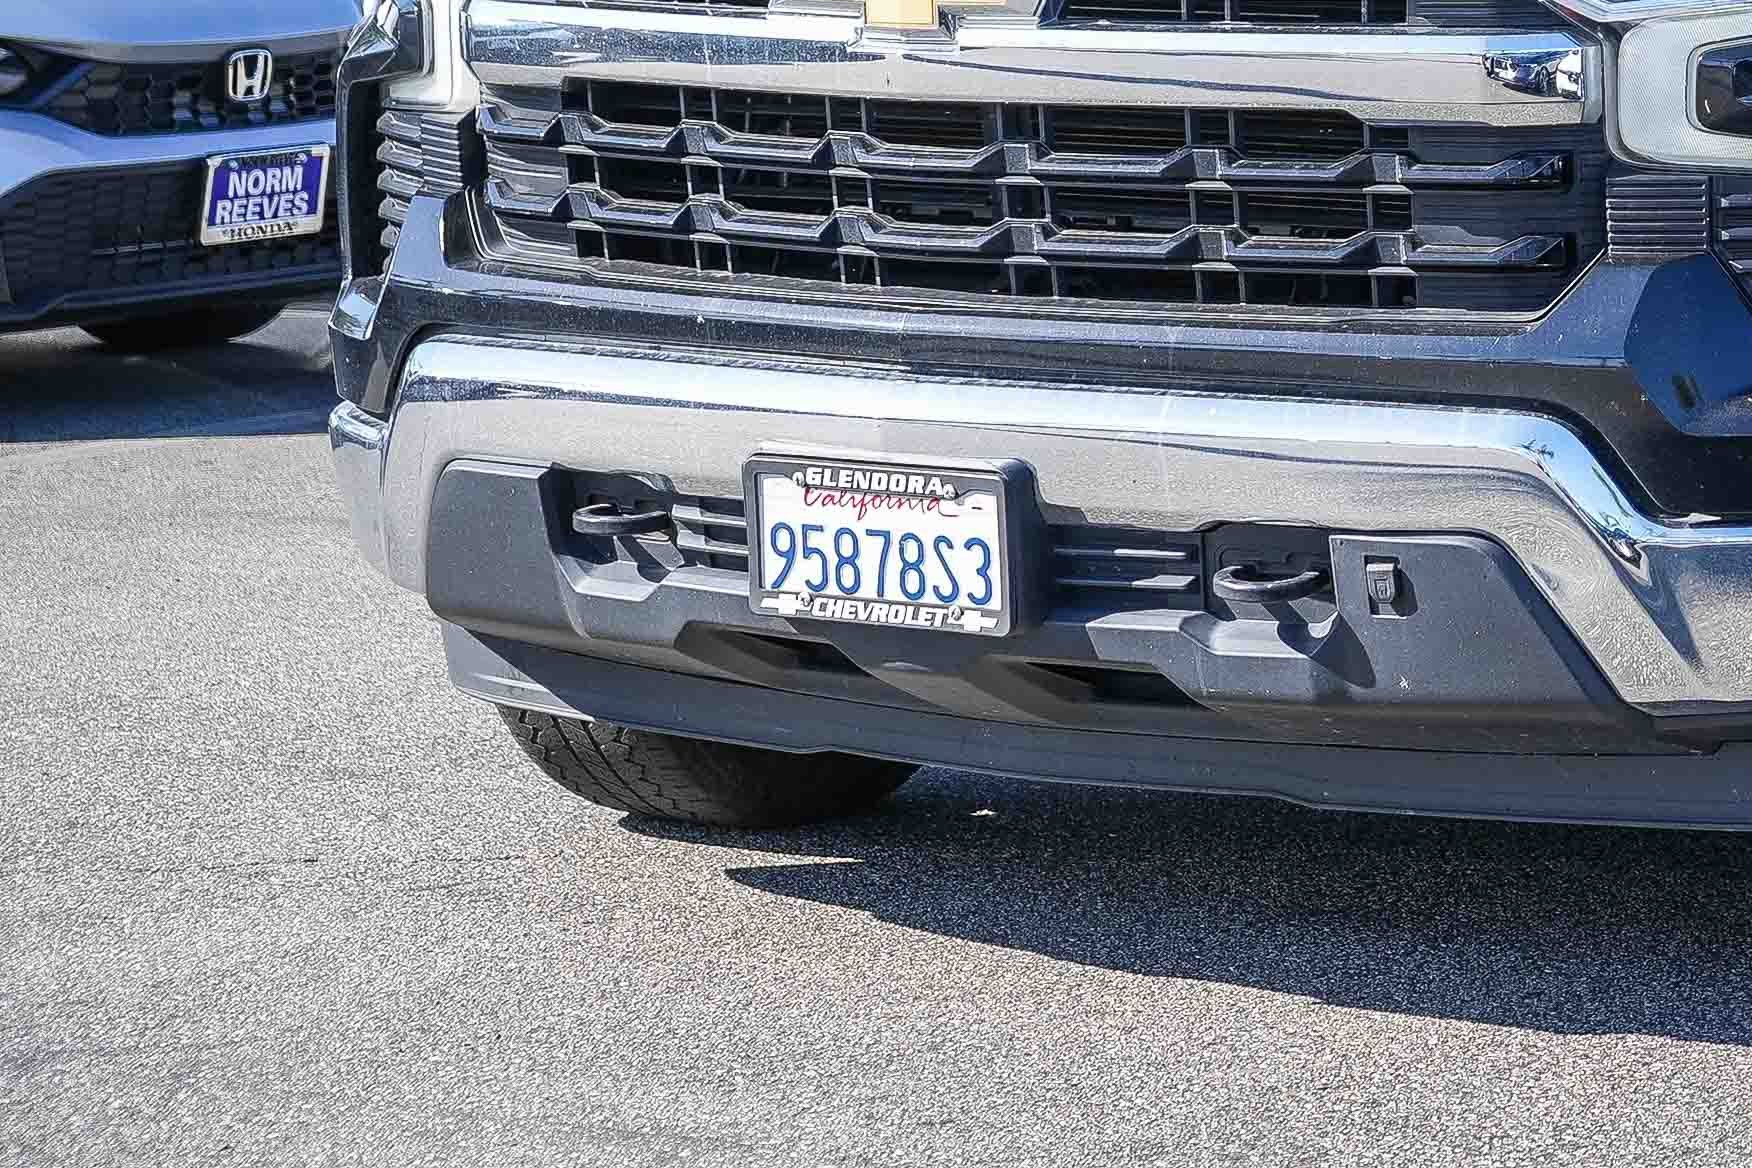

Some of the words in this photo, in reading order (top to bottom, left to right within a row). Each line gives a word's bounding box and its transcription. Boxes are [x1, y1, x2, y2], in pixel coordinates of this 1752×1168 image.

[227, 165, 304, 199] NORM
[215, 190, 309, 225] REEVES
[229, 221, 294, 240] HONDA
[805, 466, 945, 497] GLENDORA
[802, 485, 959, 521] California
[769, 521, 993, 607] 95878S3
[811, 595, 951, 628] CHEVROLET
